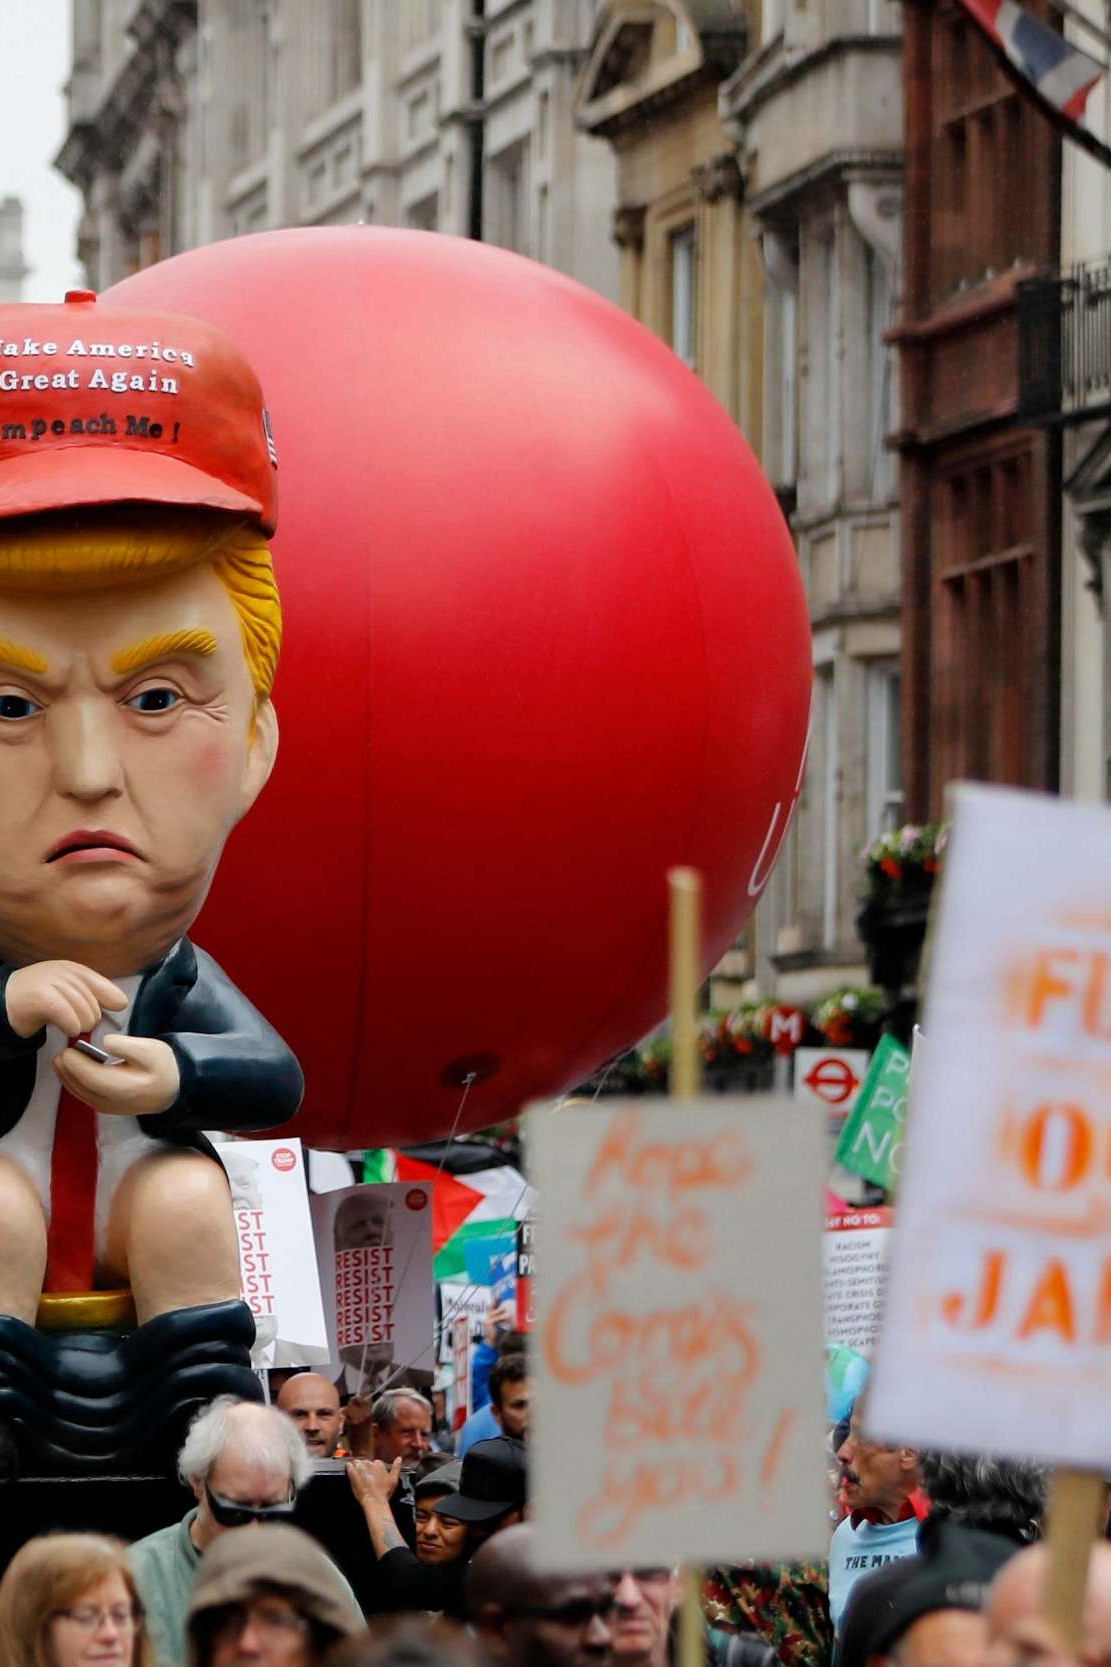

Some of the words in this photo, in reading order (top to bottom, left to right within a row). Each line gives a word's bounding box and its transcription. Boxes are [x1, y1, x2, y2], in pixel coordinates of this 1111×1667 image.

[66, 339, 194, 367] America
[88, 368, 178, 394] Again
[770, 1012, 803, 1044] M
[335, 1247, 393, 1270] RESIST
[335, 1266, 393, 1290] RESIST
[336, 1286, 393, 1308] RESIST
[337, 1305, 393, 1327] RESIST
[845, 1556, 868, 1570] THE
